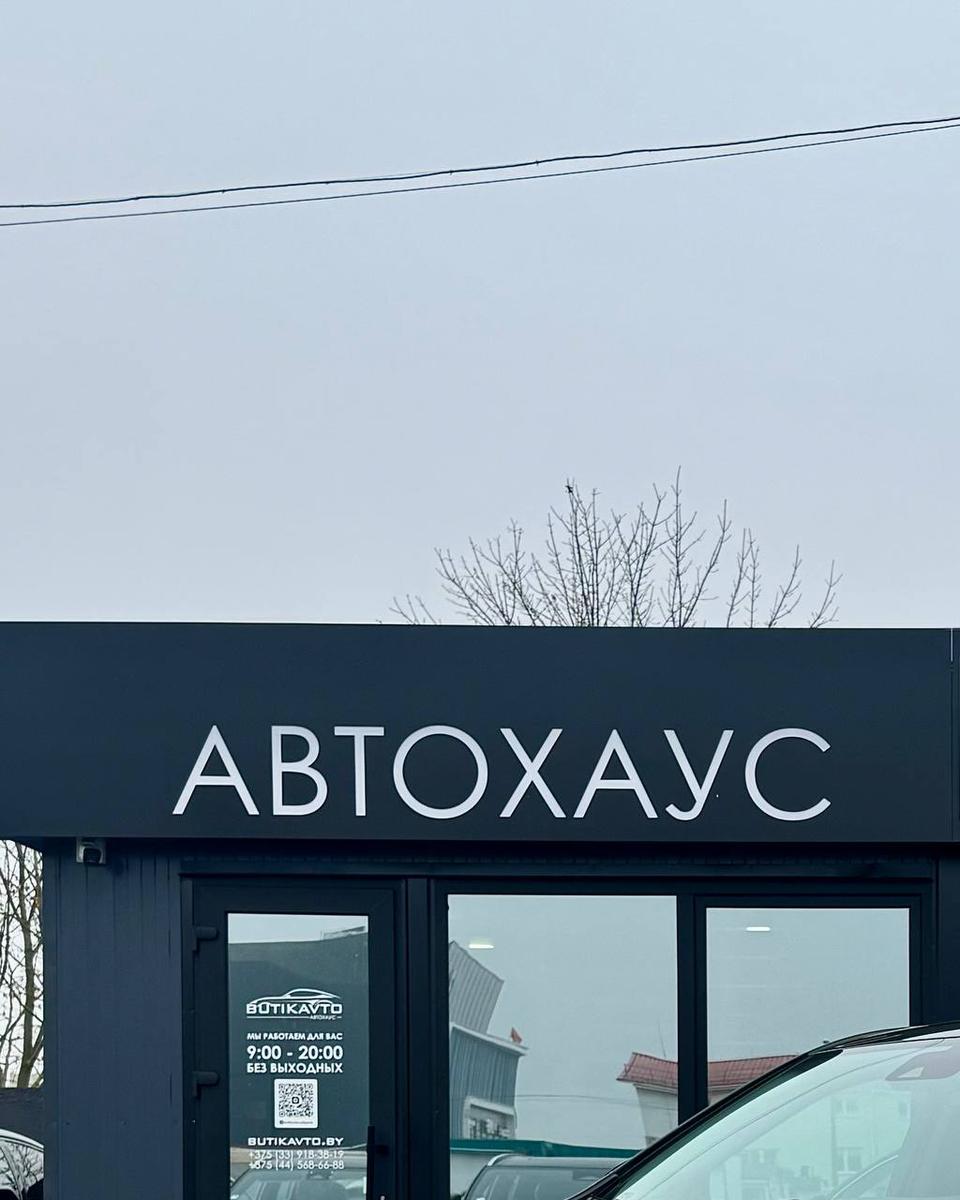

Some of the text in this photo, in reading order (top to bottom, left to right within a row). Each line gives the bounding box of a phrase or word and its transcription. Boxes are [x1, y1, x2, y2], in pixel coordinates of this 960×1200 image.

[172, 724, 832, 821] АВТОХАУС
[246, 1003, 342, 1014] BUTIKAVTO
[247, 1045, 281, 1059] 9:00
[298, 1045, 343, 1059] 20:00
[247, 1063, 343, 1073] БЕЗ ВЫХОДНЫХ
[248, 1137, 344, 1146] BUTIKAVTO.BY
[249, 1150, 272, 1159] +375
[275, 1150, 293, 1160] (33)
[275, 1160, 293, 1171] (44)
[297, 1160, 344, 1169] 568-66-88
